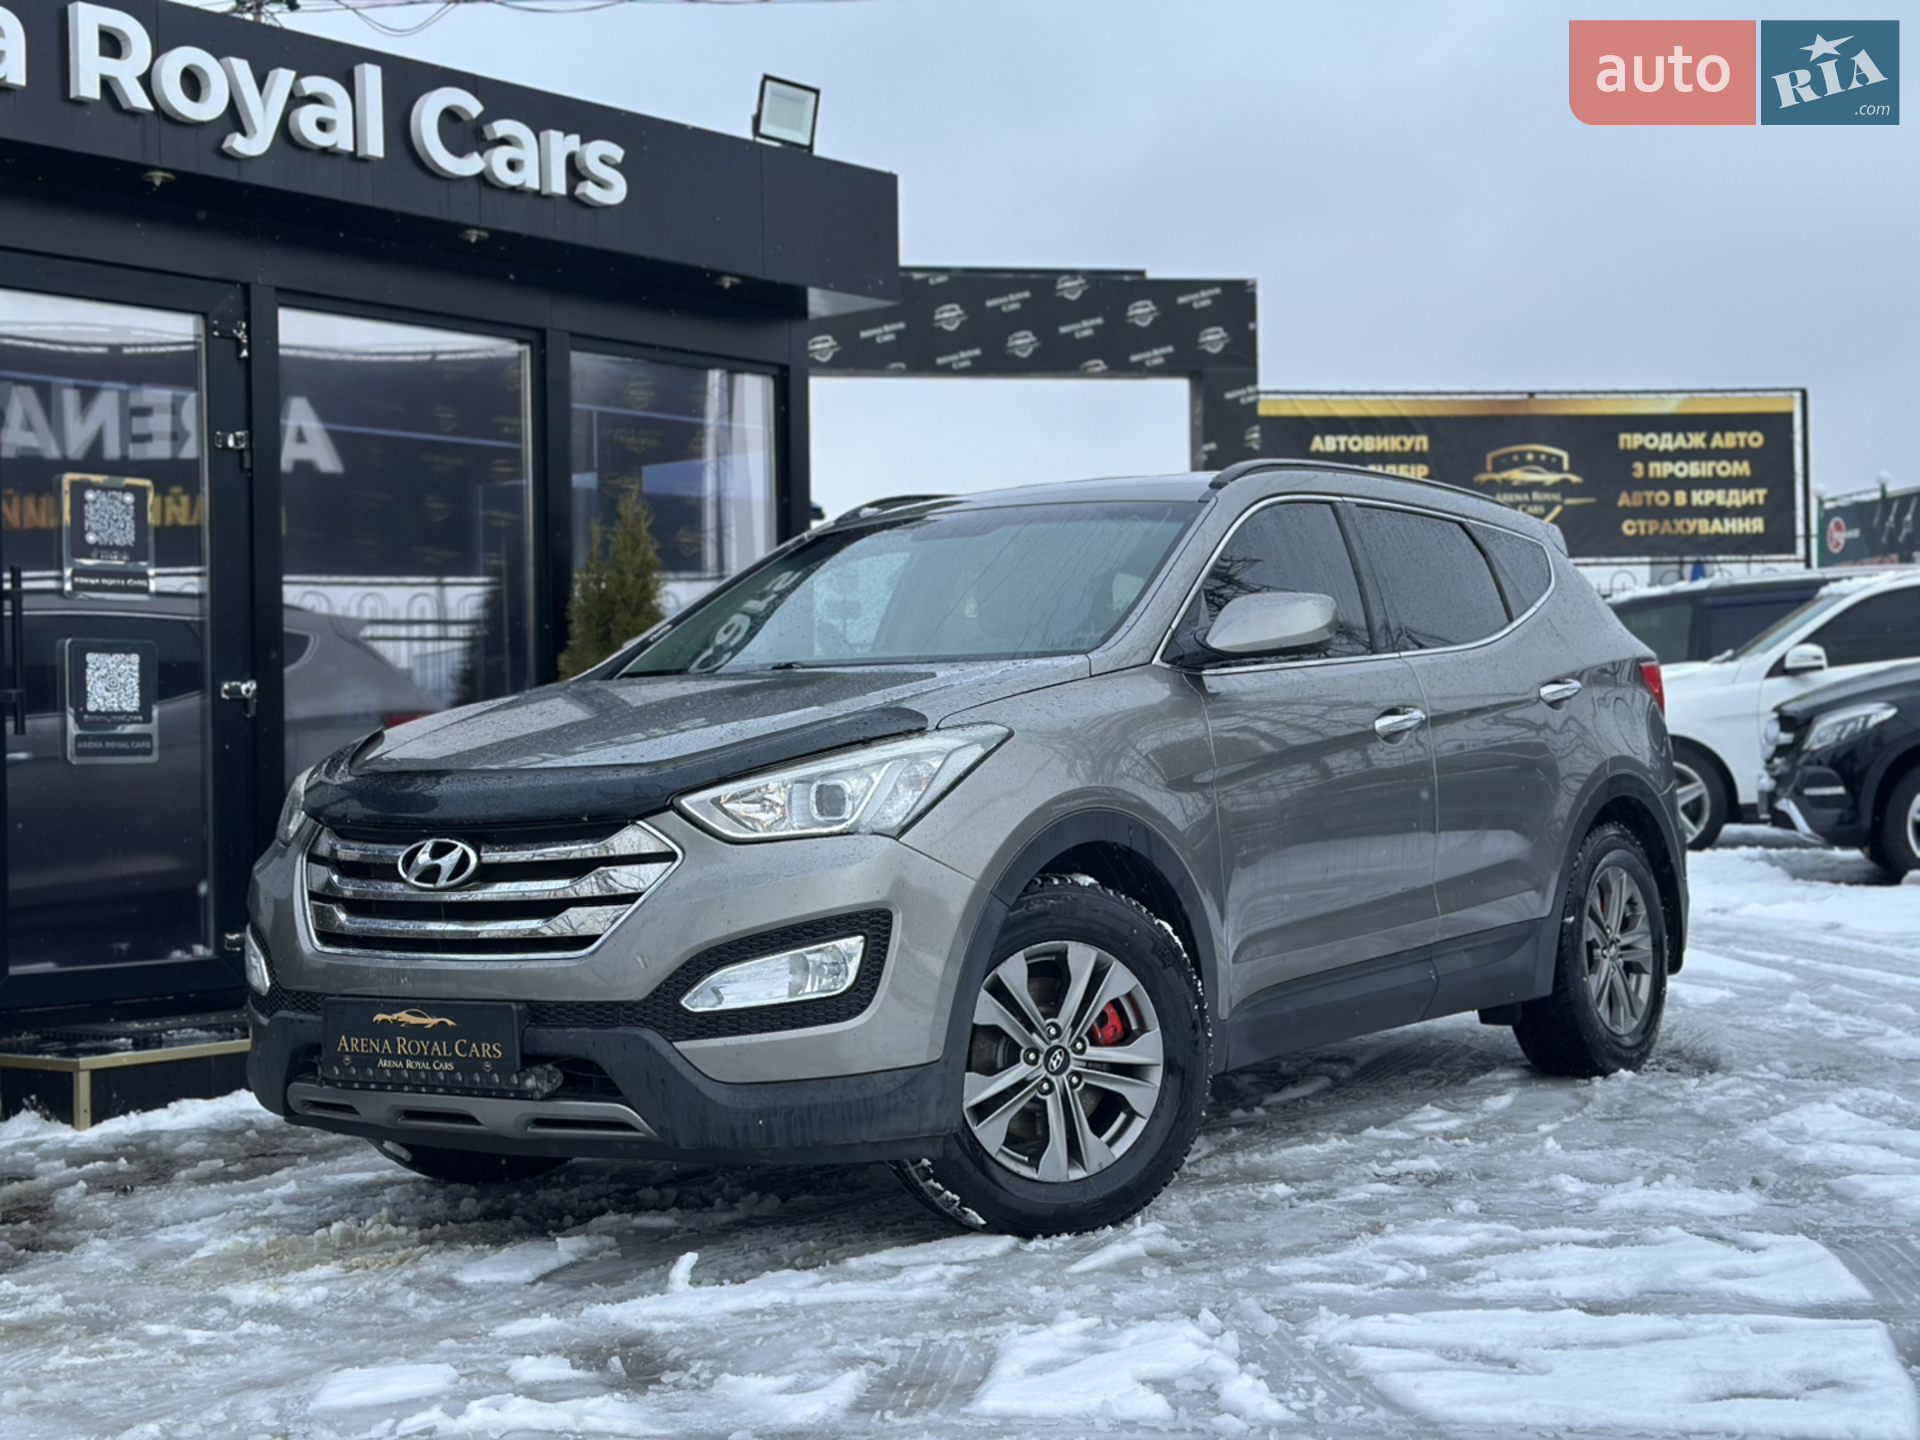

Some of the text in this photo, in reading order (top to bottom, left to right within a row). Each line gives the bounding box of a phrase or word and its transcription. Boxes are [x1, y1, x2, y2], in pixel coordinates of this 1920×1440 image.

[67, 0, 385, 160] Royal
[409, 85, 628, 206] Cars
[1309, 434, 1430, 453] АВТОВИКУП
[1618, 431, 1765, 451] ПРОДАЖ АВТО
[1632, 460, 1752, 479] З ПРОБІГОМ
[1617, 488, 1768, 508] АВТО В КРЕДИТ
[1621, 517, 1765, 536] СТРАХУВАННЯ
